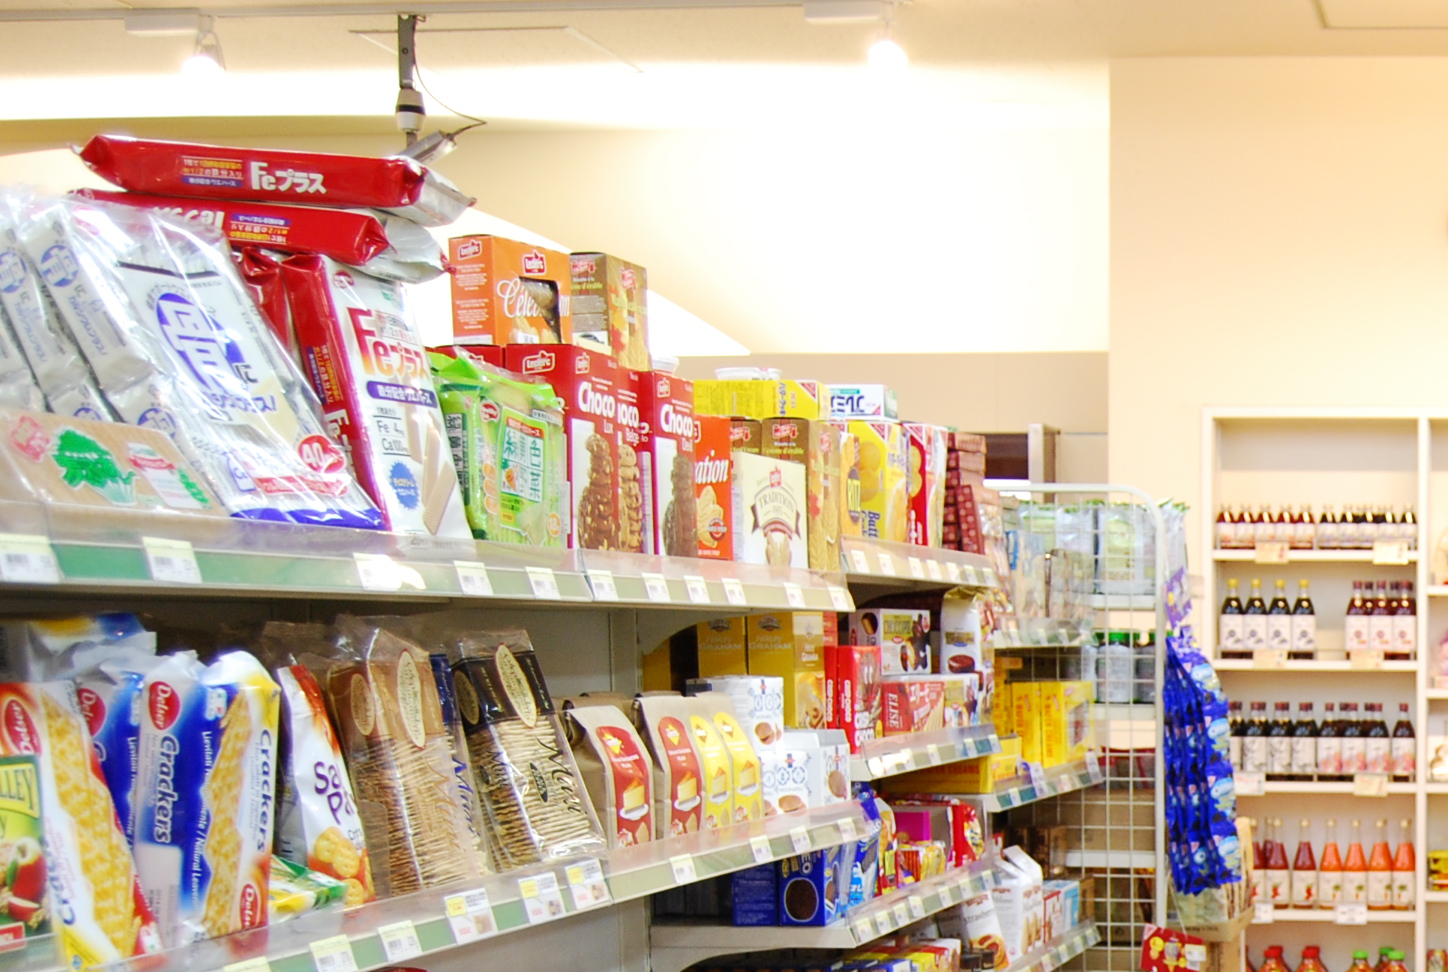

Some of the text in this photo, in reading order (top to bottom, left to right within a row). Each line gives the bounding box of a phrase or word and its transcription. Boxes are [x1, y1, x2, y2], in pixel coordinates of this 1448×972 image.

[251, 161, 327, 194] Feプラス
[347, 307, 430, 378] Feプラス
[578, 381, 616, 418] Choco
[660, 403, 694, 438] Choco
[304, 442, 325, 467] 40
[888, 692, 900, 729] ELISE
[153, 733, 180, 845] Crackers
[256, 728, 274, 853] Crackers
